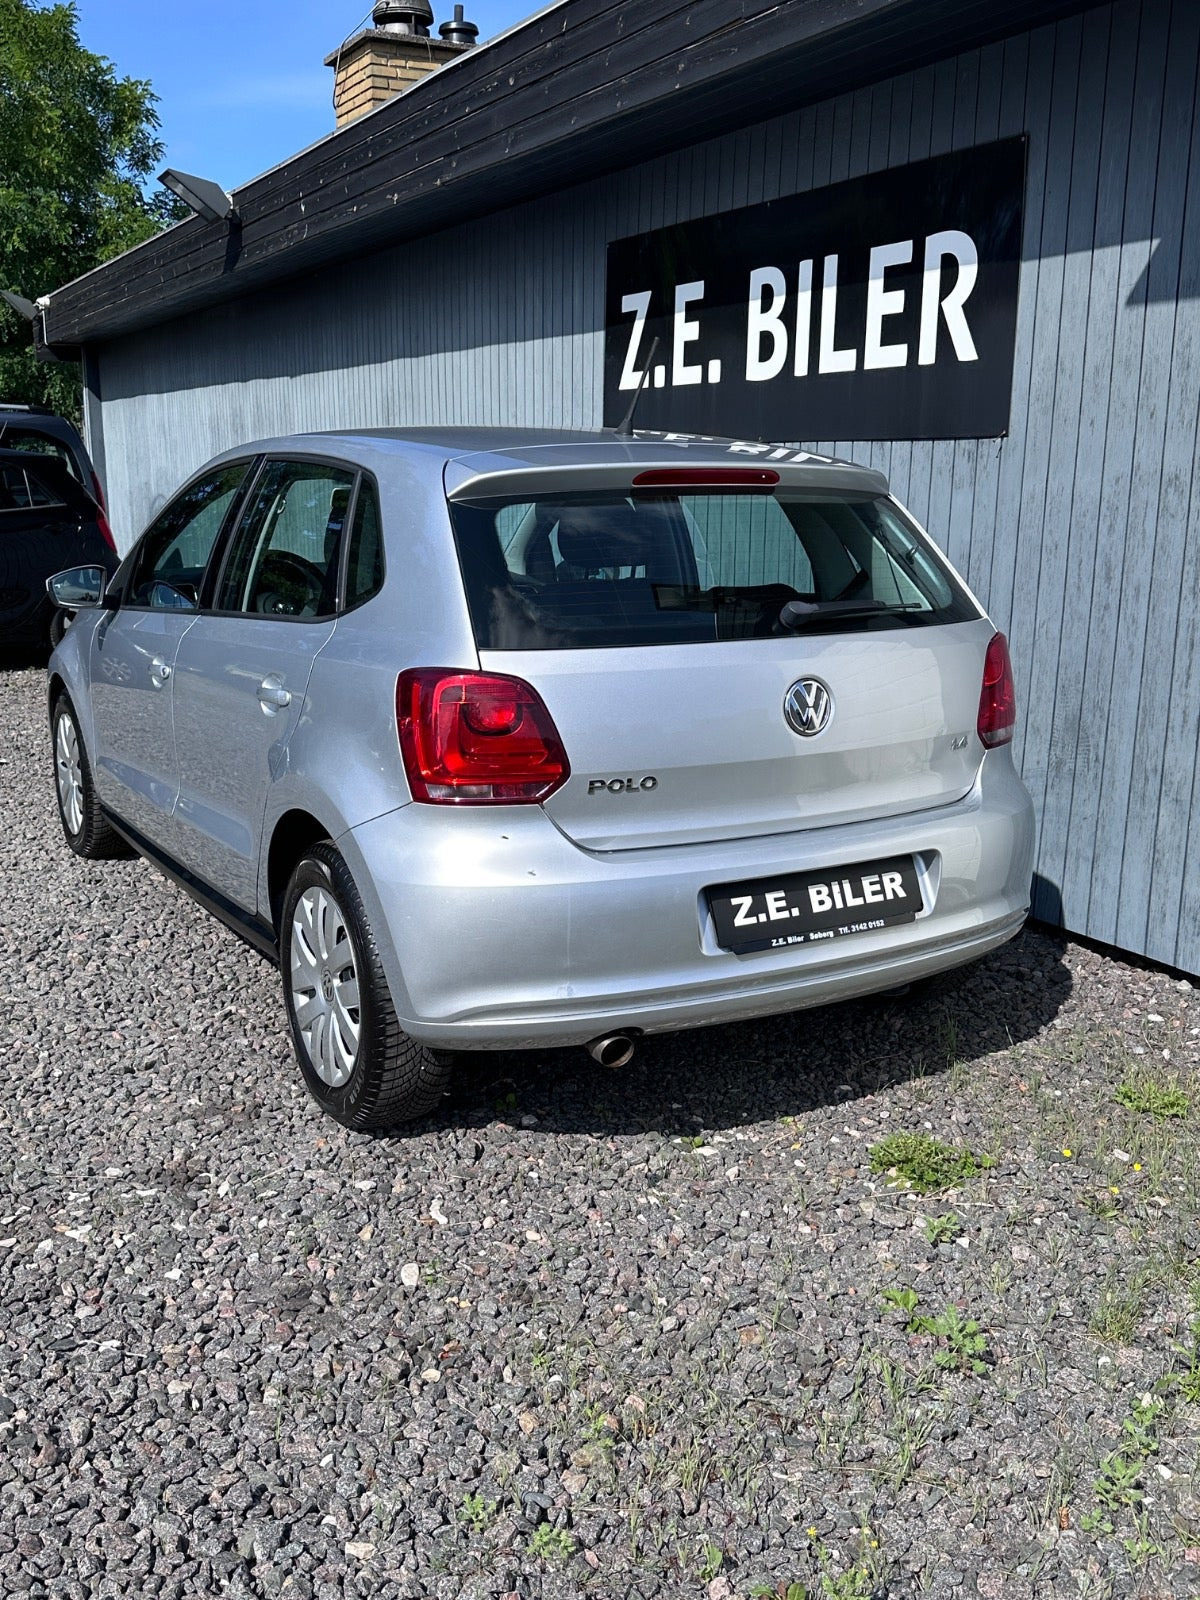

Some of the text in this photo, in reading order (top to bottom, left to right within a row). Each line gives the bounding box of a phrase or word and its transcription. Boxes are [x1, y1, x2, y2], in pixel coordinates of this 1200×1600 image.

[618, 229, 979, 391] Z.E. BILER
[587, 776, 659, 796] POLO
[730, 871, 907, 927] Z.E. BILER
[851, 923, 868, 932] 3142
